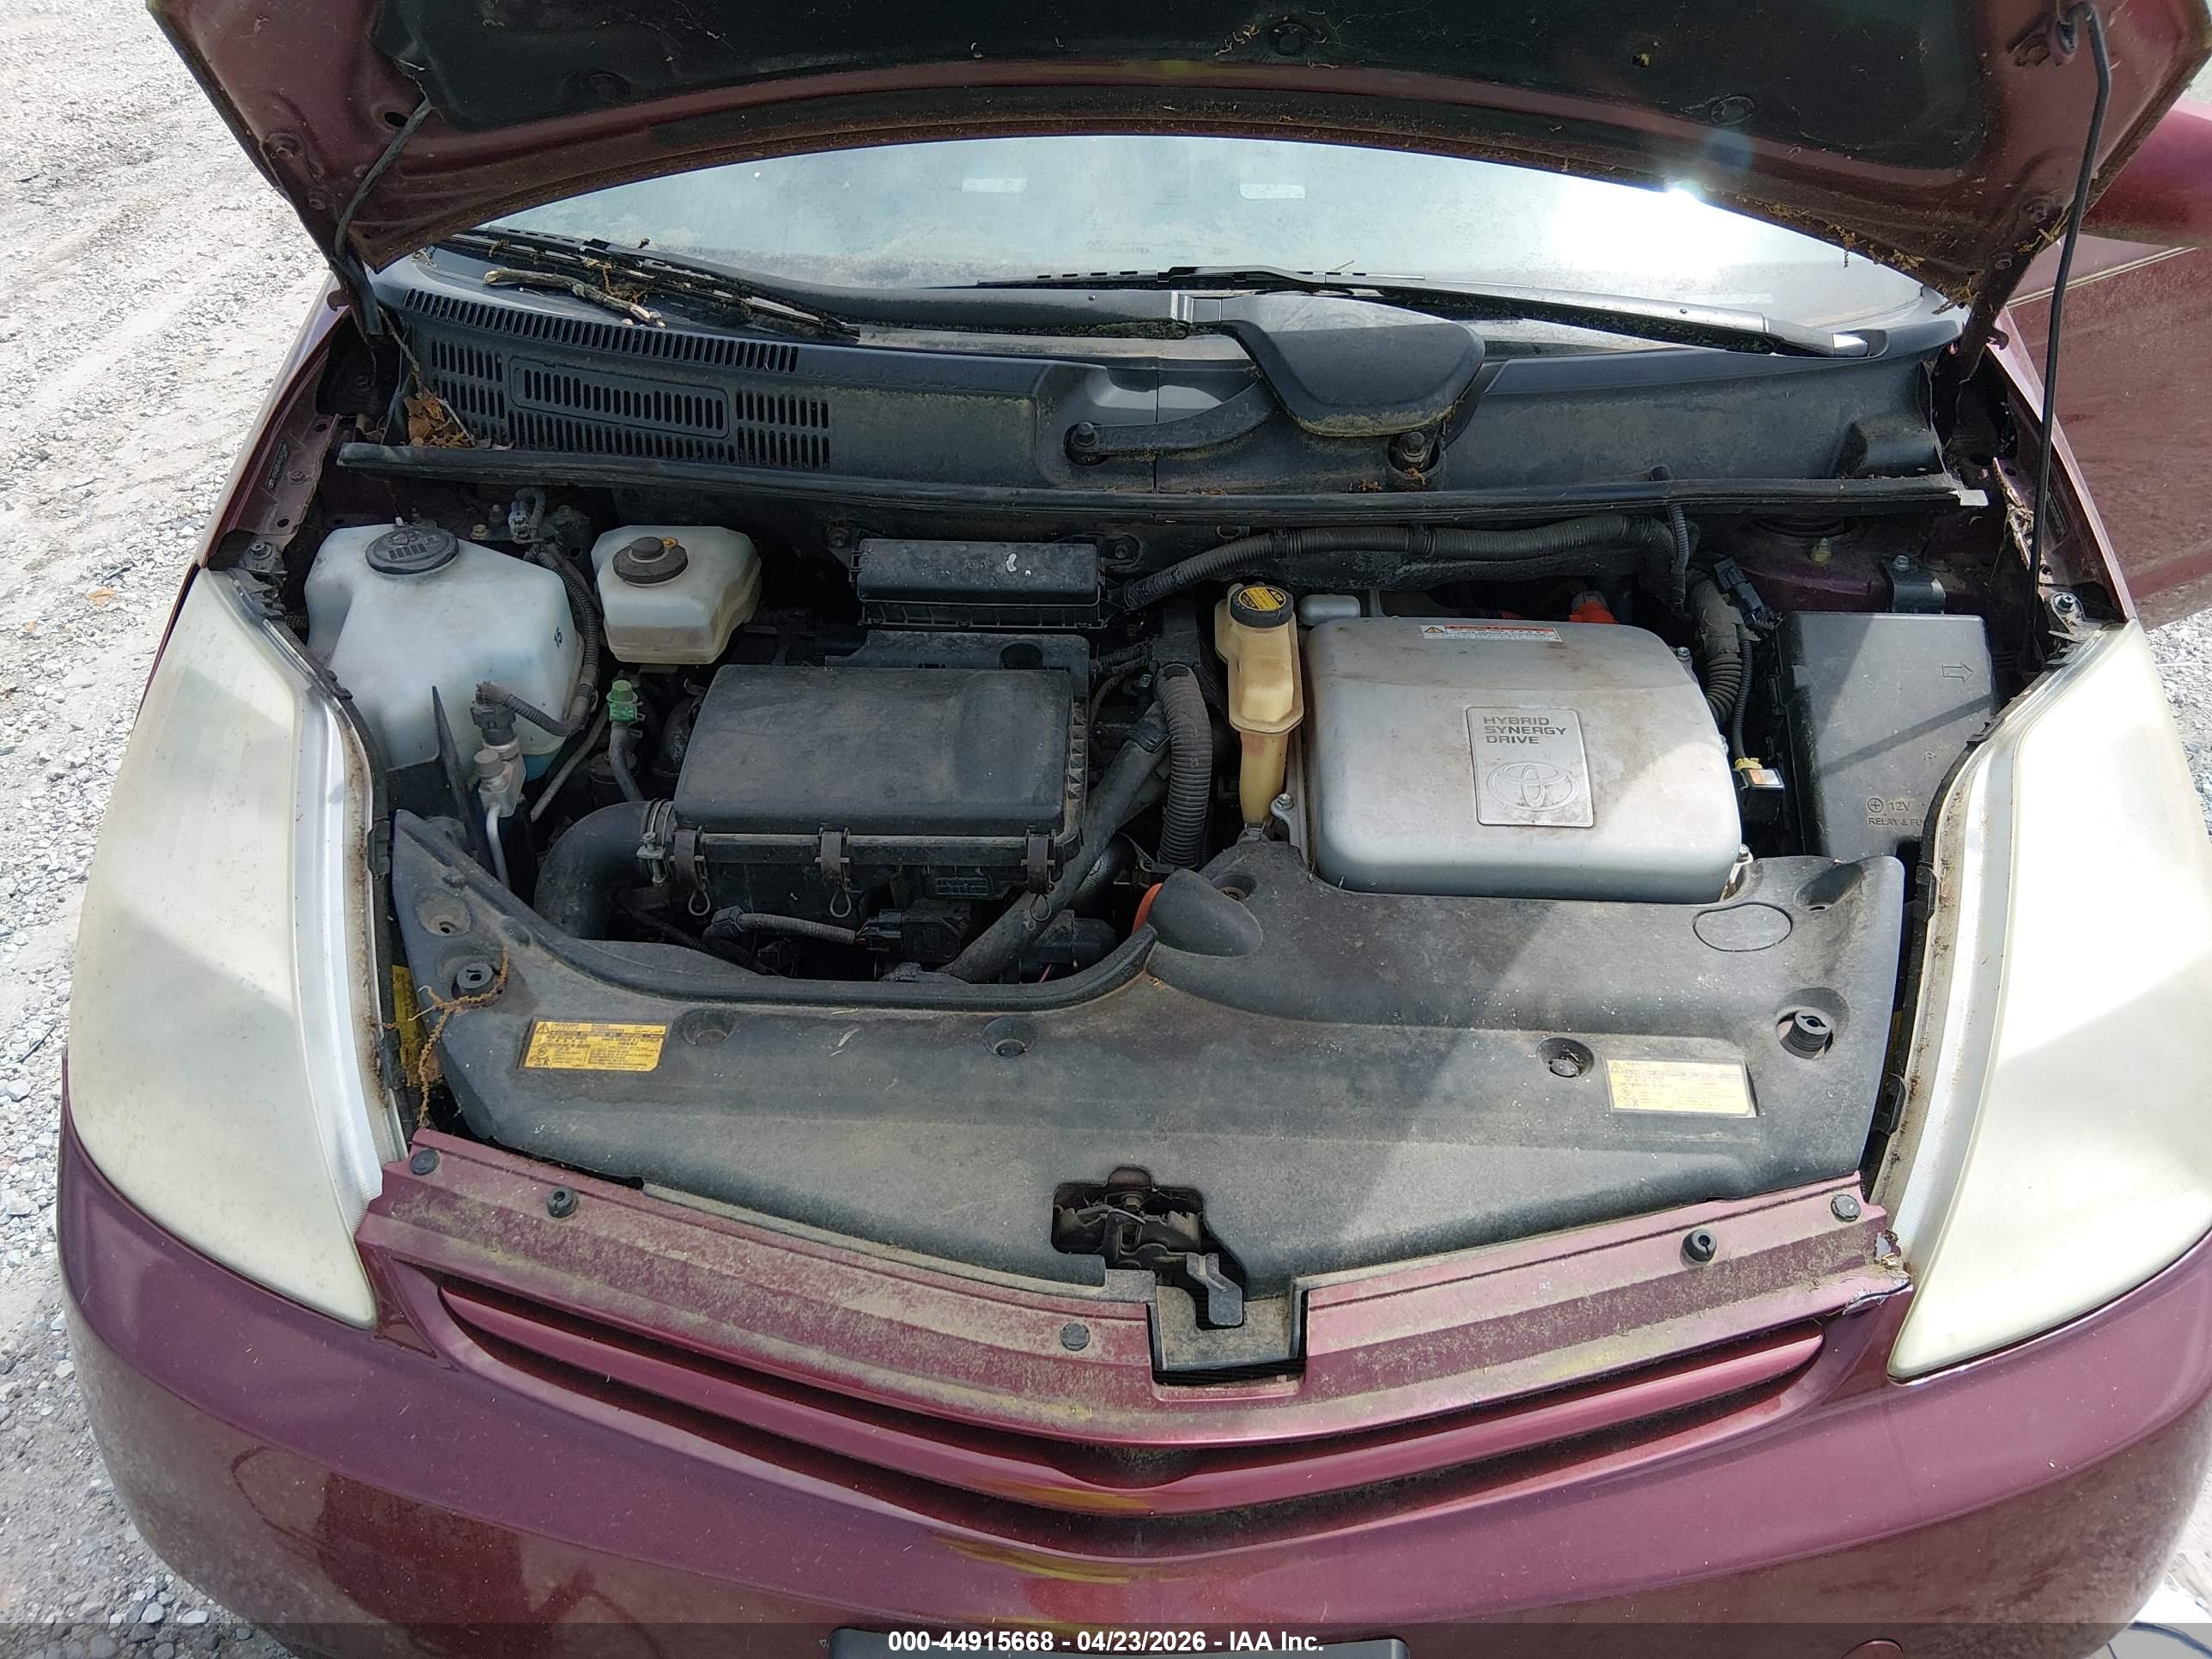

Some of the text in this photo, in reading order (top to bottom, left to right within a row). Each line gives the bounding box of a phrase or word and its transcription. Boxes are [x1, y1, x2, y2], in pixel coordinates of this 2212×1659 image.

[1483, 716, 1549, 726] HYBRID
[1484, 726, 1566, 735] SYNERGY
[1486, 735, 1539, 744] DRIVE
[1889, 801, 1911, 811] 12V
[1869, 817, 1897, 826] RELAY
